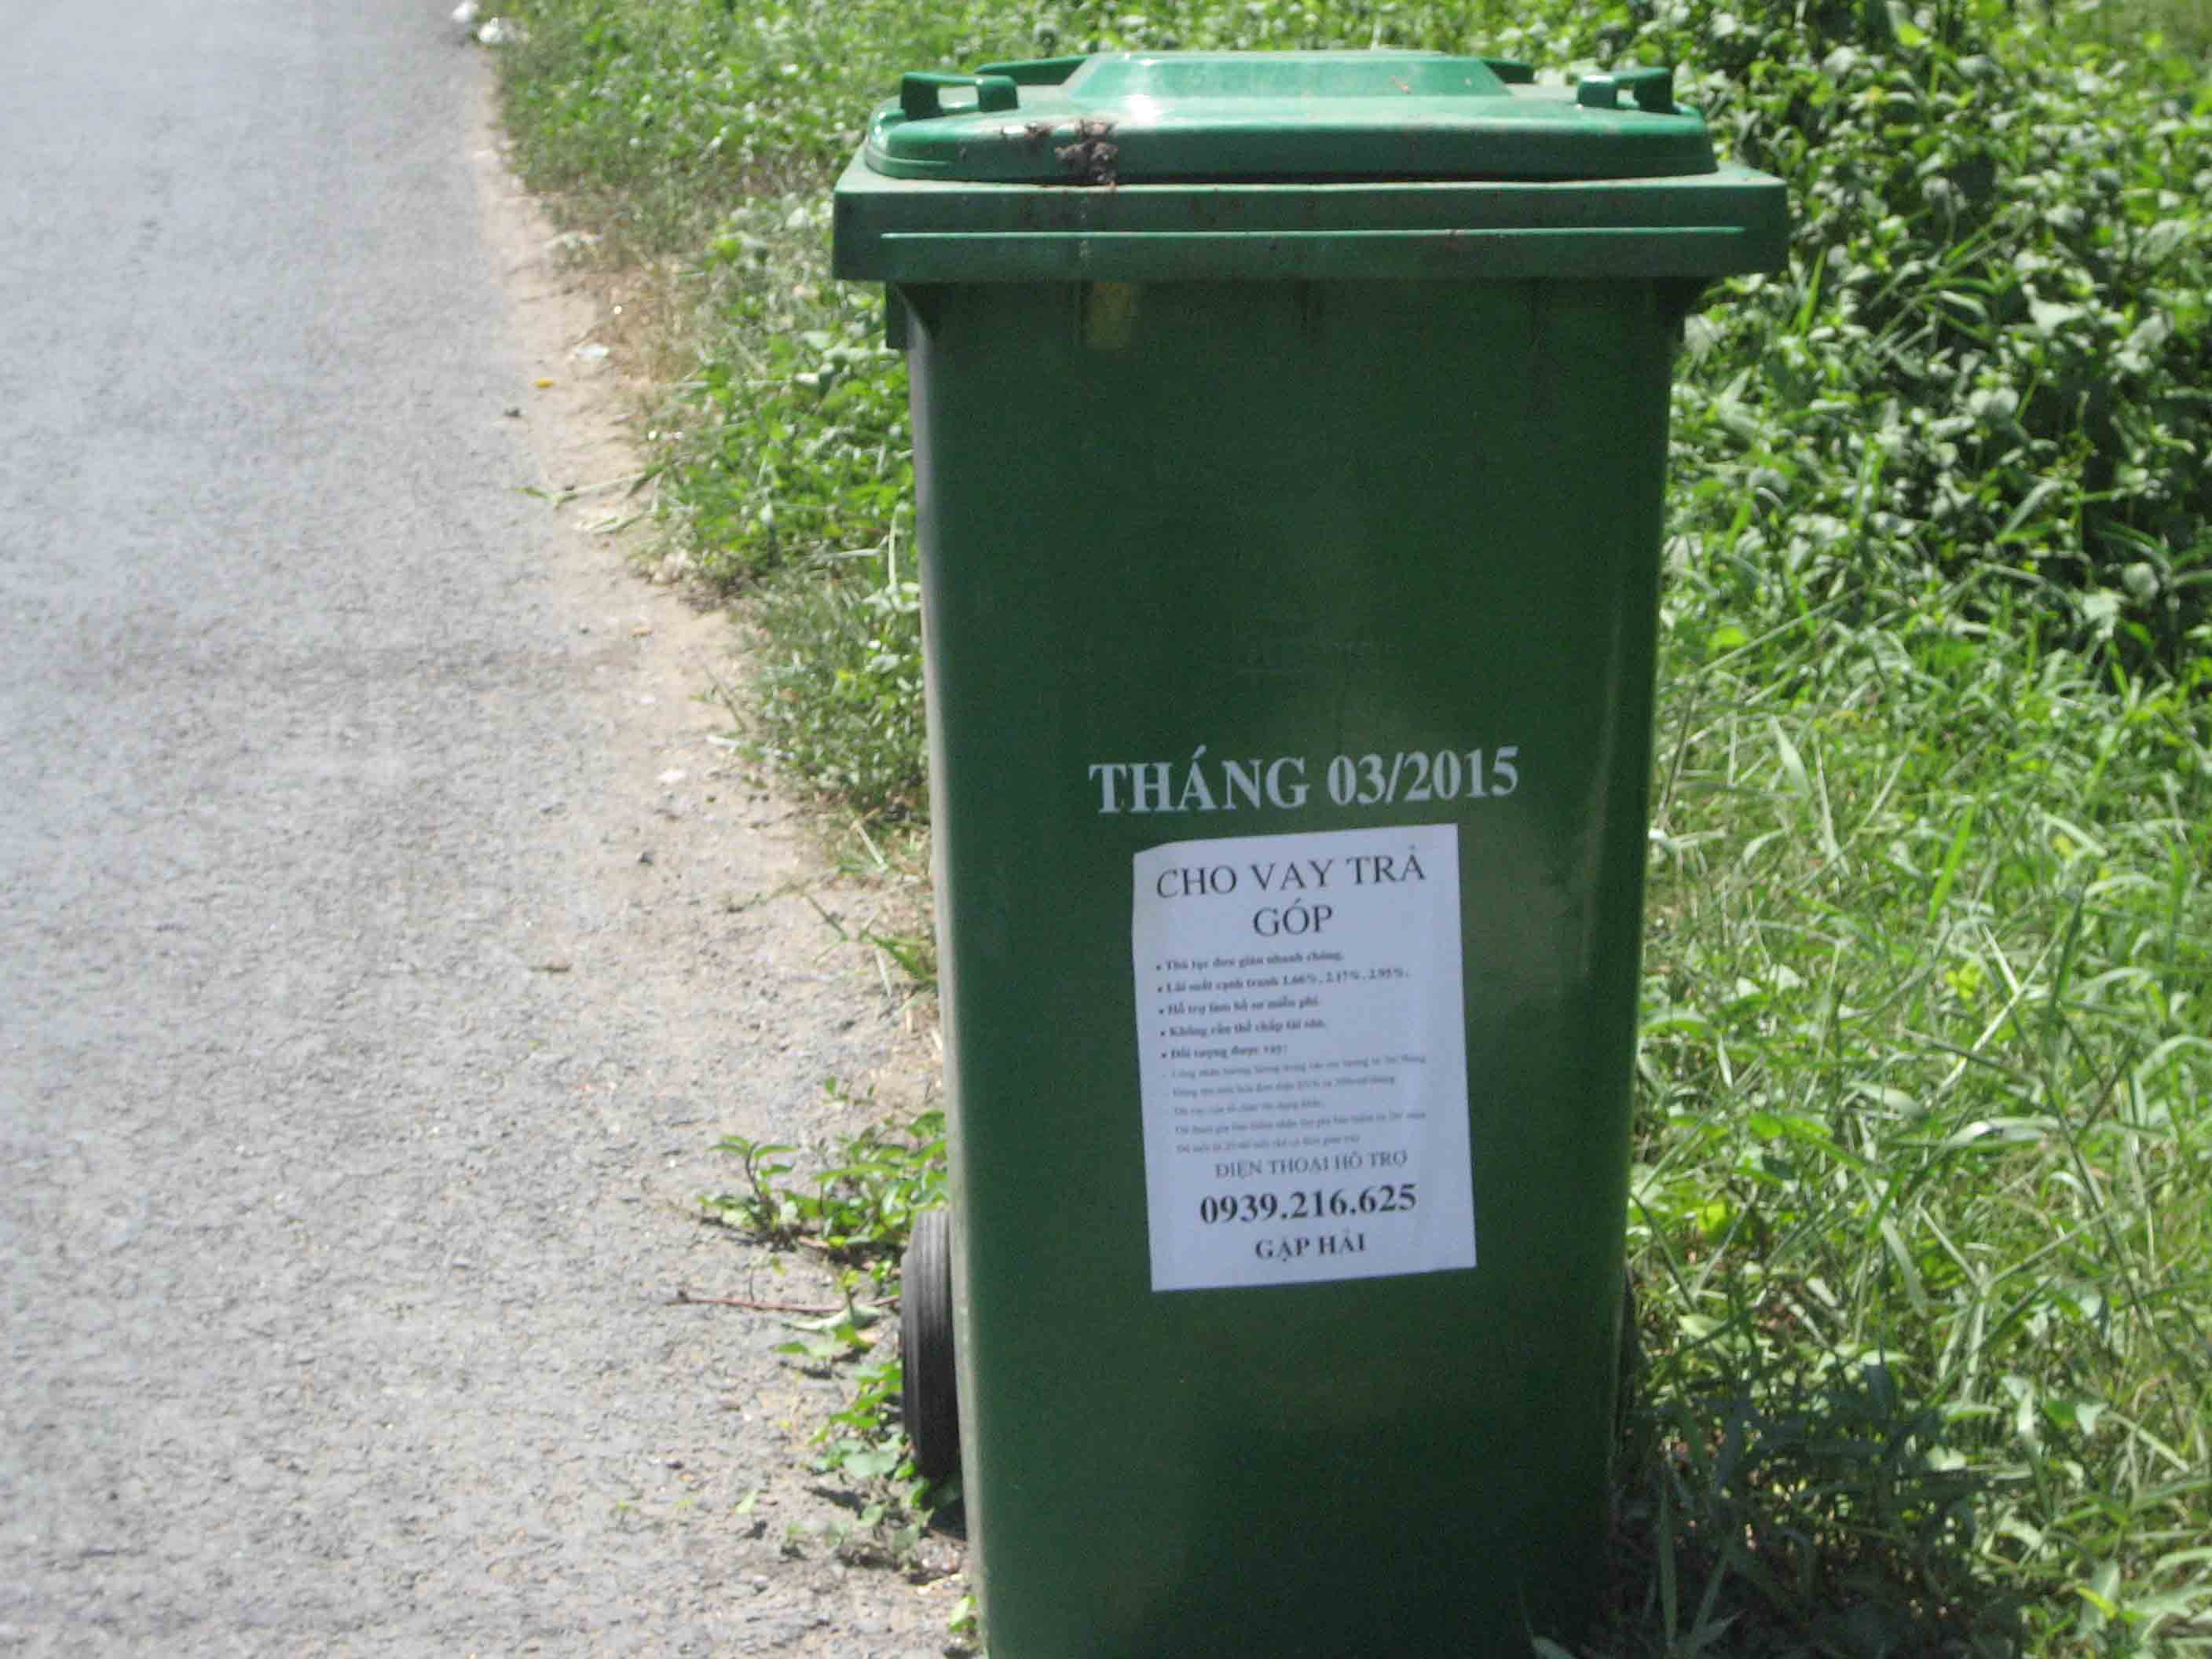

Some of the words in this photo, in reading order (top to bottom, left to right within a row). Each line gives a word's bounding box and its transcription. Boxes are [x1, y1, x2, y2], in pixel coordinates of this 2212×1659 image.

[1089, 745, 1311, 814] THÁNG
[1327, 745, 1520, 806] 03/2015
[1156, 865, 1237, 899] CHO
[1251, 859, 1334, 891] VAY
[1346, 845, 1426, 885] TRẢ
[1252, 899, 1334, 937] GÓP
[1200, 1183, 1417, 1224] 0939.216.625
